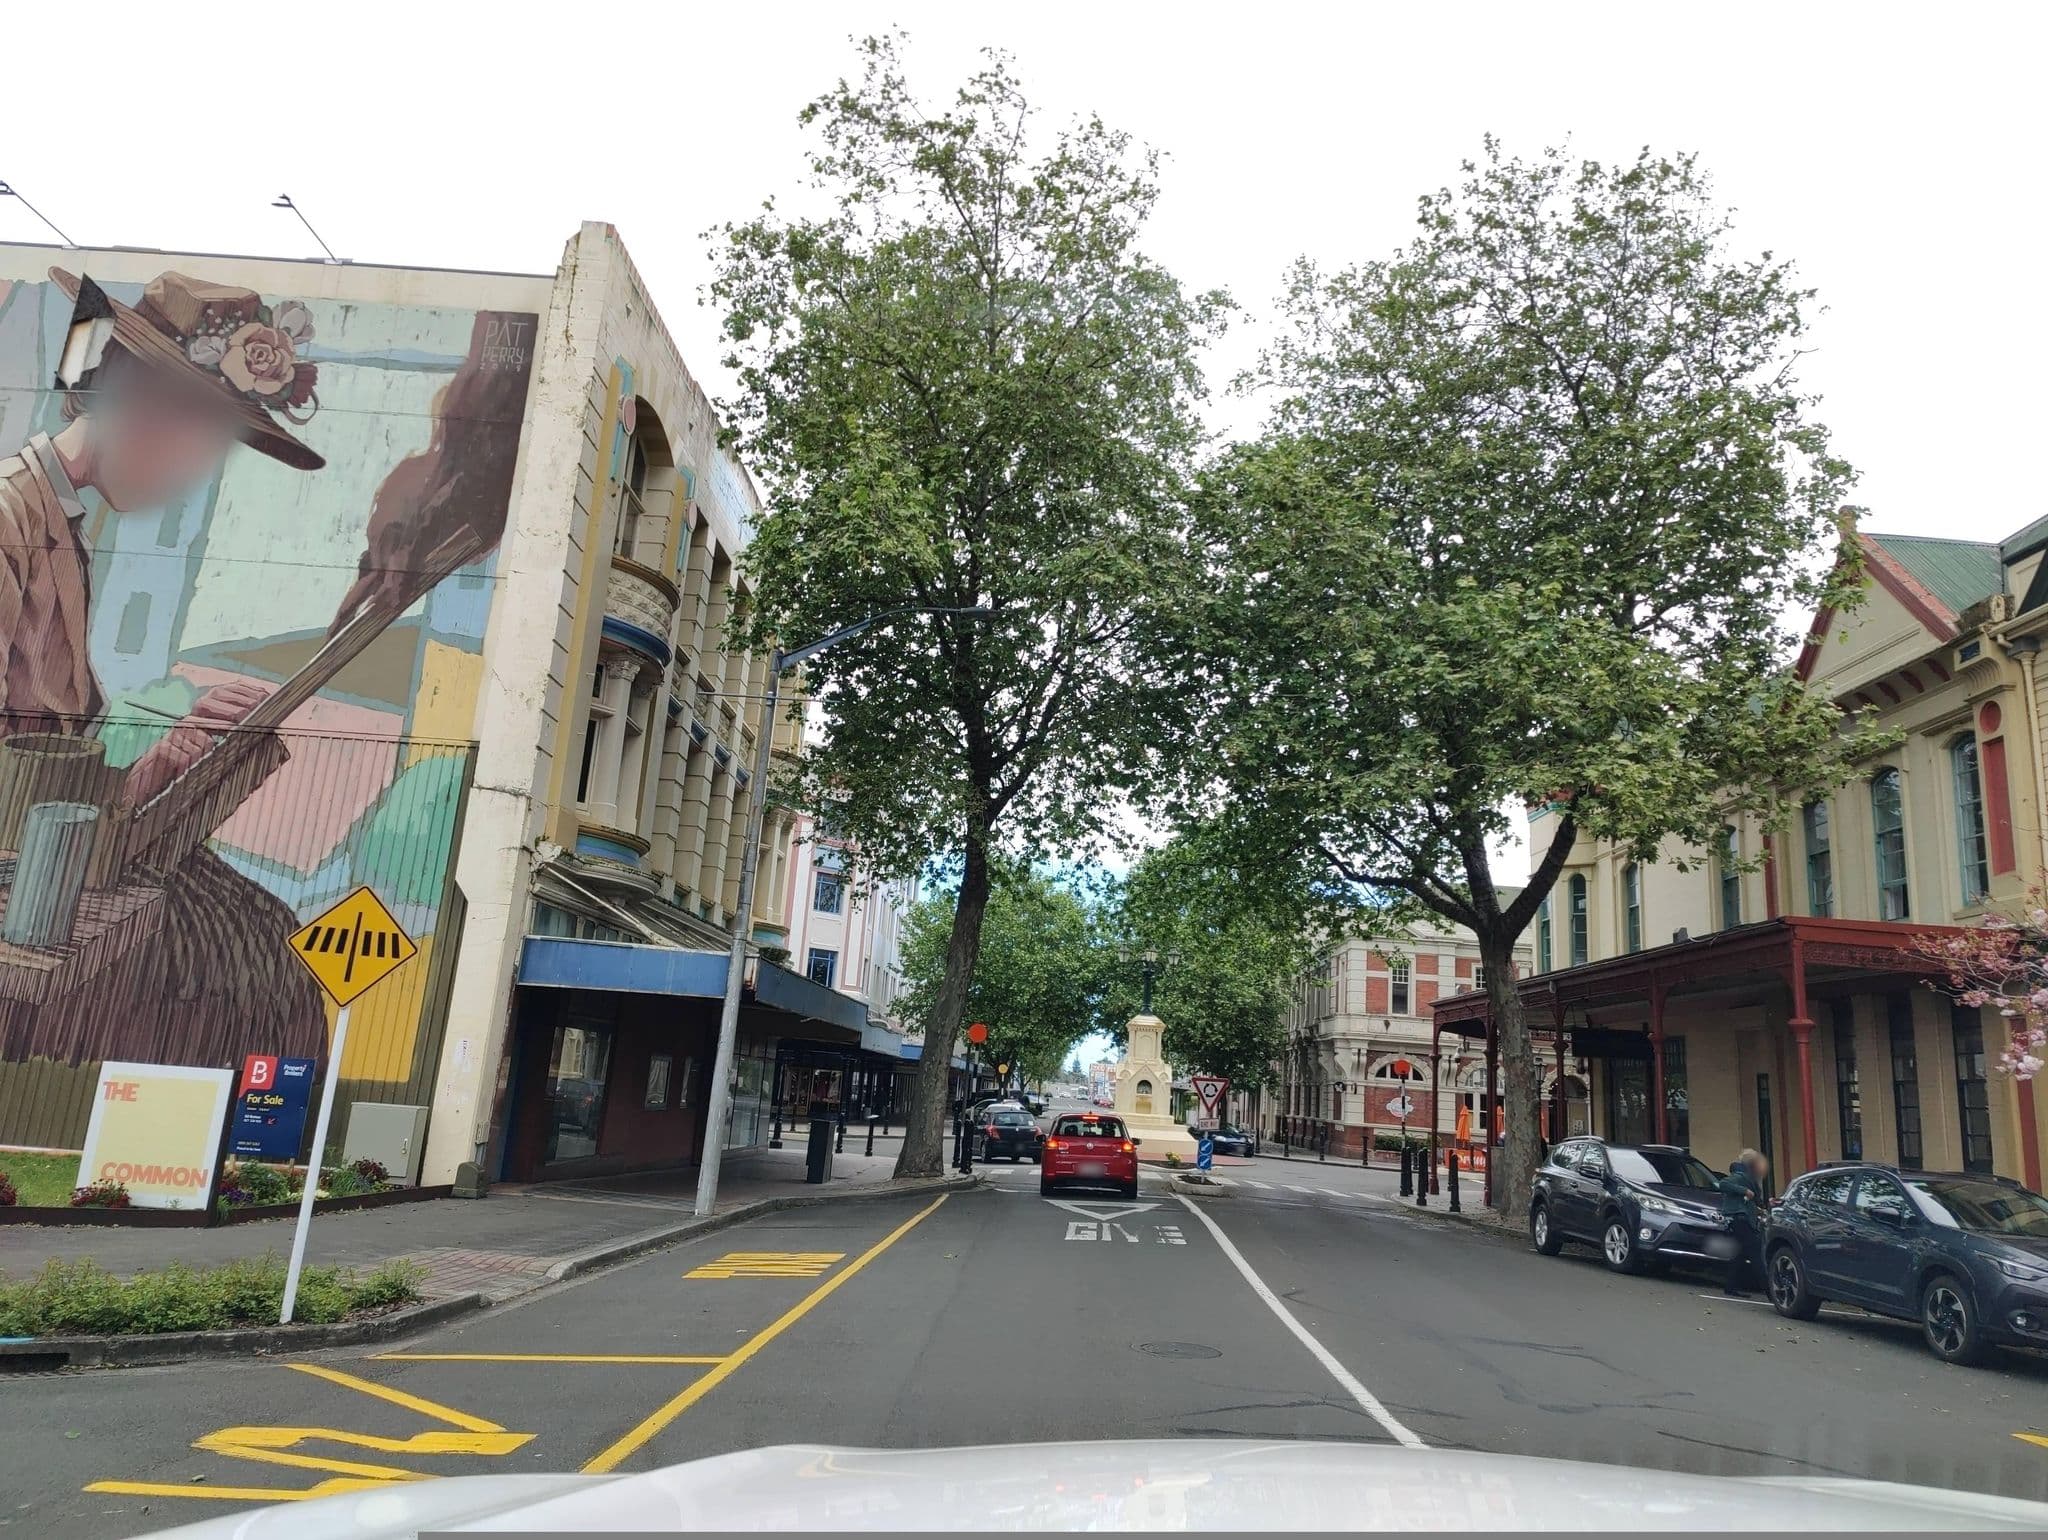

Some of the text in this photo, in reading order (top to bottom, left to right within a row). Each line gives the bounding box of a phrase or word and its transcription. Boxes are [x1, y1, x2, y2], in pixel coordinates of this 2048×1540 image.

[483, 320, 528, 346] PAT
[482, 346, 523, 362] PERRY
[252, 1061, 267, 1083] B
[103, 1081, 139, 1101] THE
[246, 1093, 284, 1106] For Sale
[101, 1163, 208, 1188] COMMON
